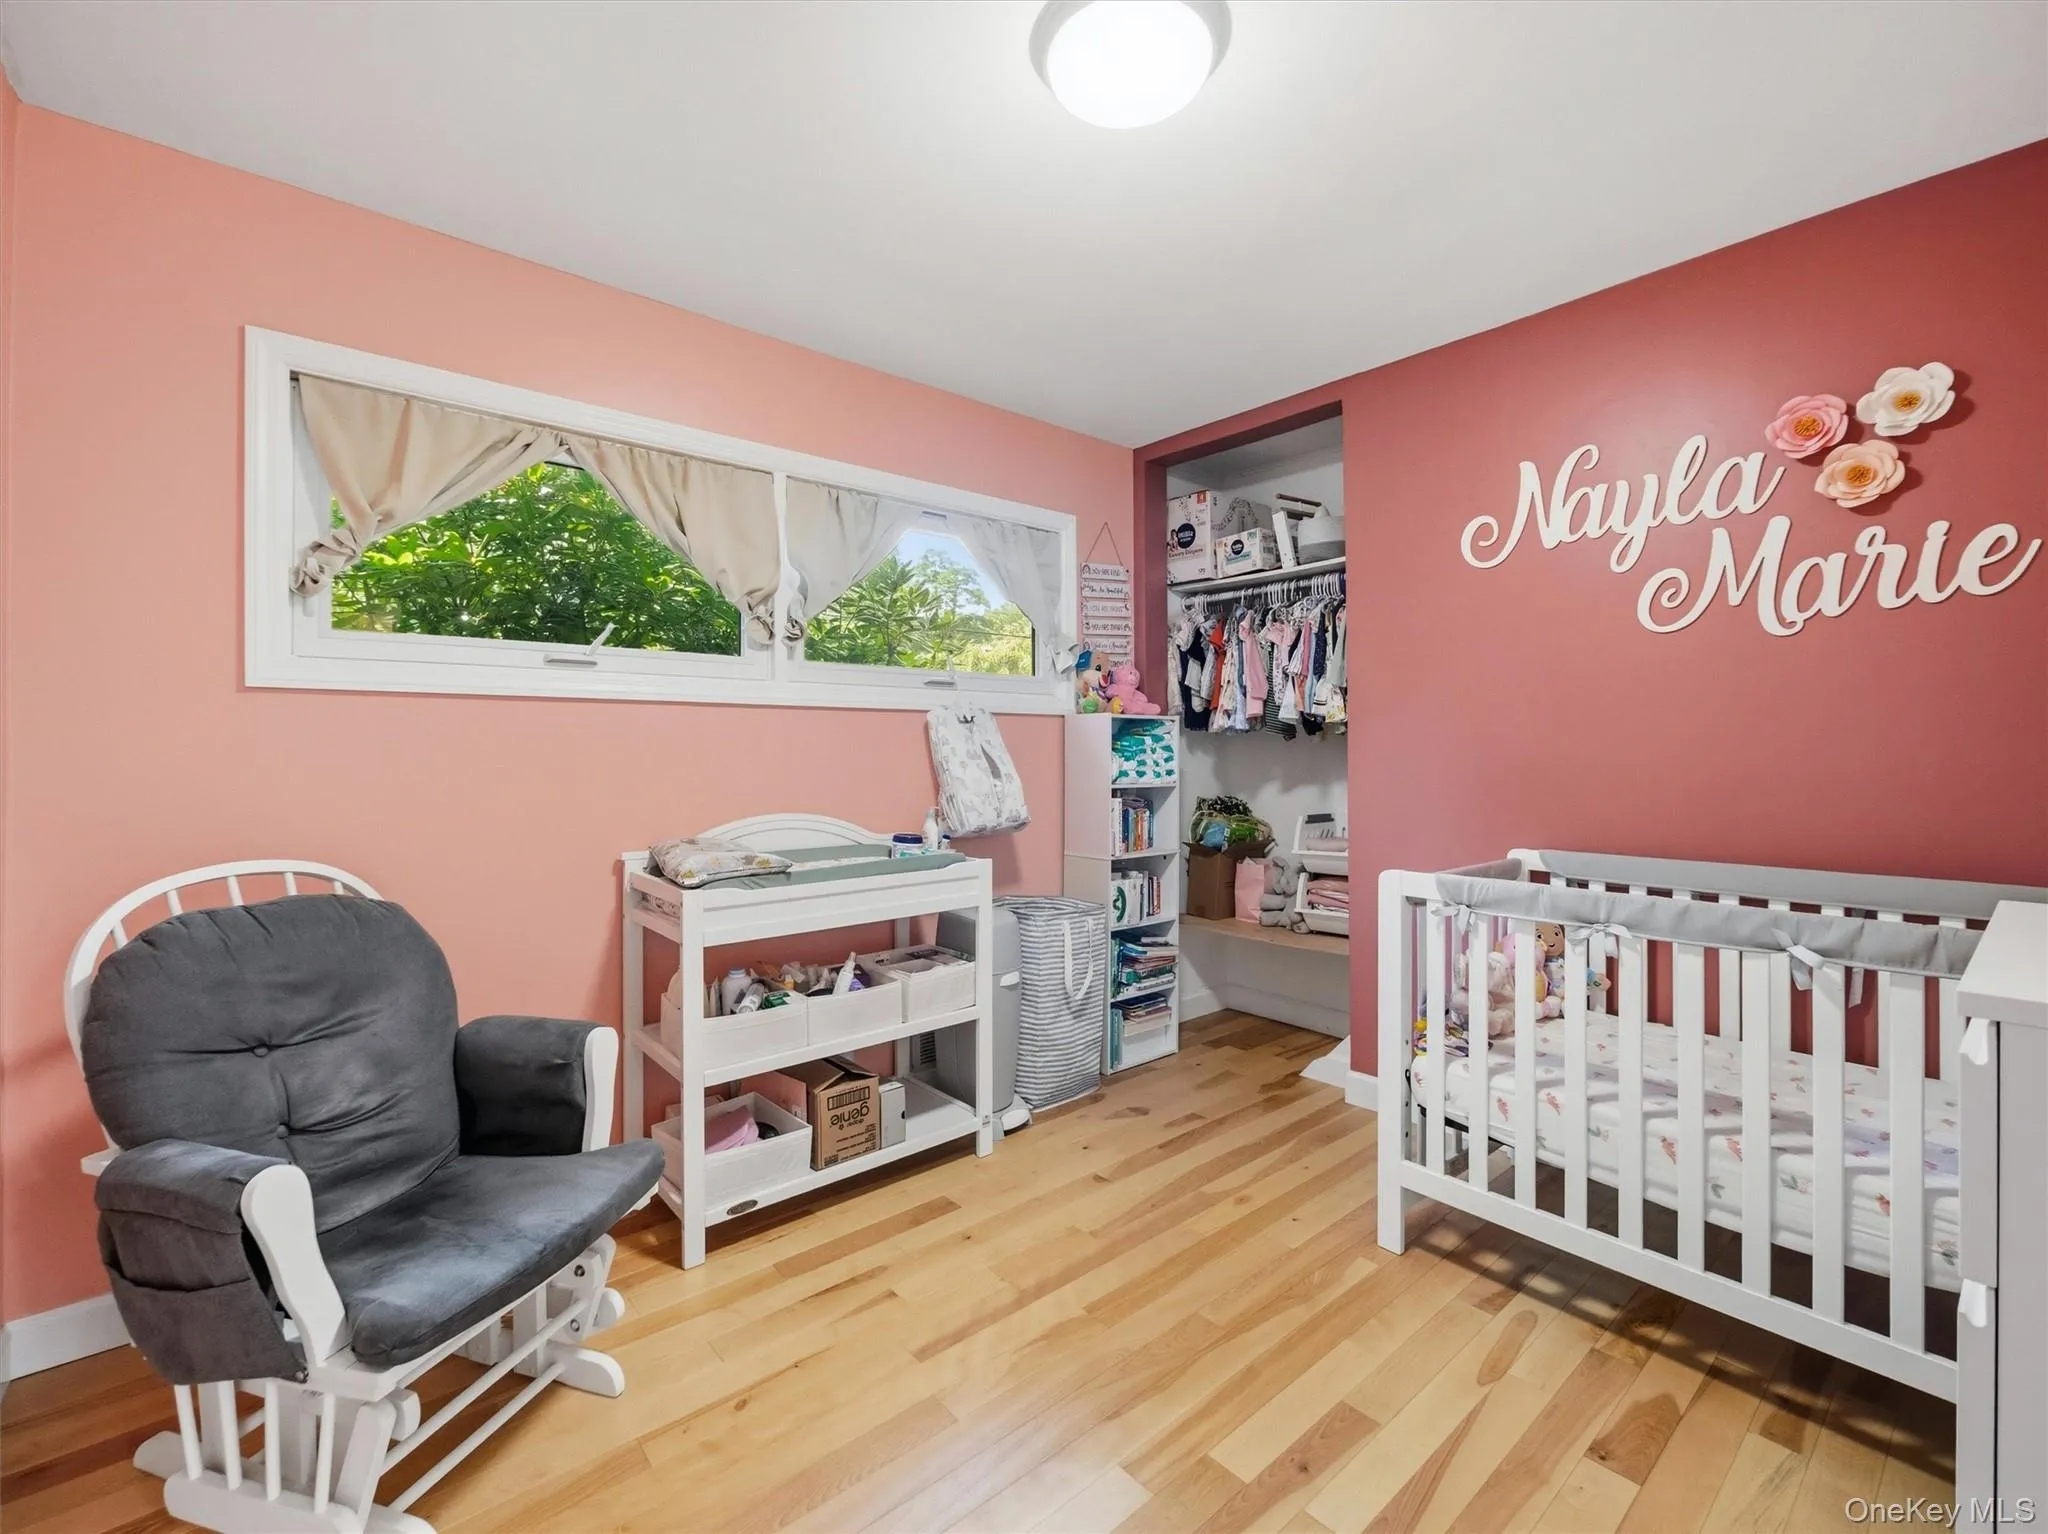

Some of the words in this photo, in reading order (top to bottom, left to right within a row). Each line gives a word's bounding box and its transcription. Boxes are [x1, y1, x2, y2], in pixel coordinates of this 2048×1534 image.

[1461, 434, 1786, 574] Nayla
[1638, 515, 2043, 637] Marie
[830, 1101, 870, 1126] genie
